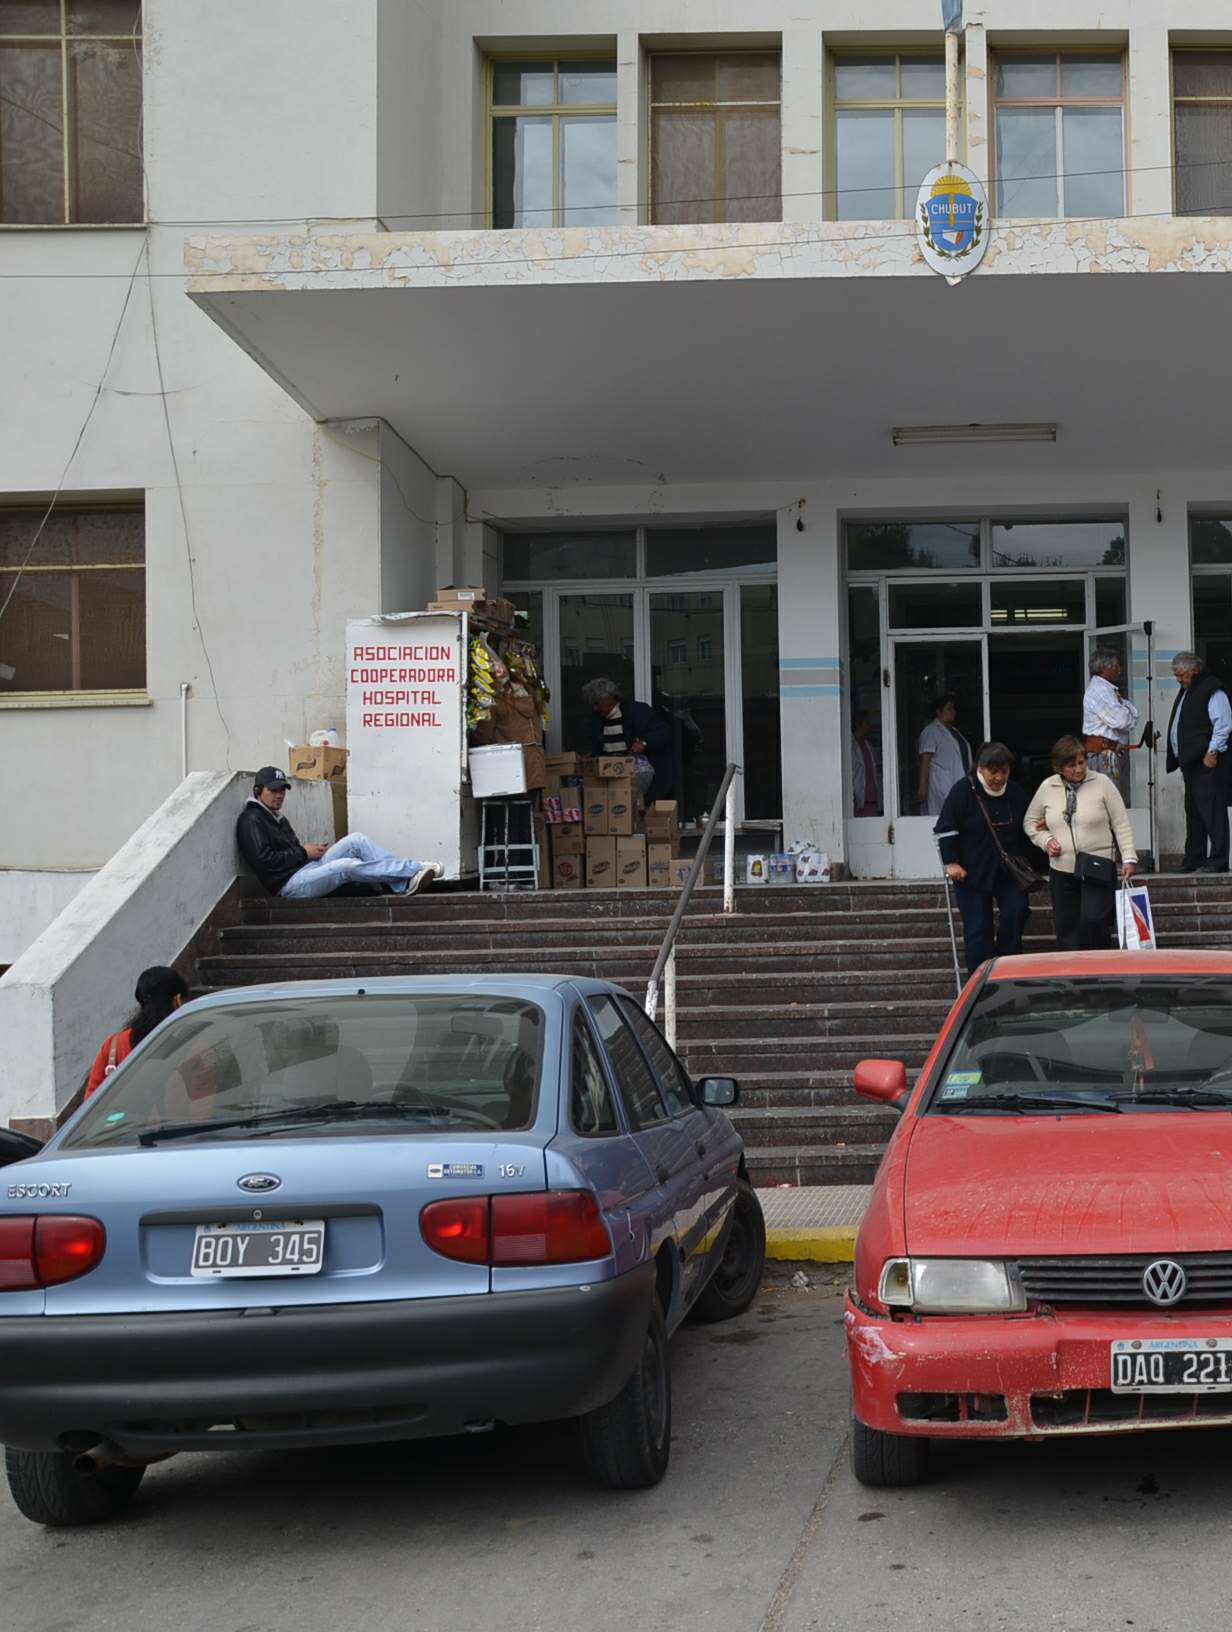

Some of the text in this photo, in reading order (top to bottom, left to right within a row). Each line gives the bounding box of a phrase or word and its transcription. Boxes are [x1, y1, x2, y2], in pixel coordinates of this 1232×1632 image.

[931, 203, 973, 215] CHUBUT
[353, 646, 451, 661] ASOCIACION
[350, 668, 456, 683] COOPERADORA
[362, 690, 442, 705] HOSPITAL
[362, 712, 442, 728] REGIONAL
[7, 1183, 73, 1199] ESCORT
[198, 1233, 319, 1266] BOY 345
[1117, 1353, 1231, 1386] DAQ 221
